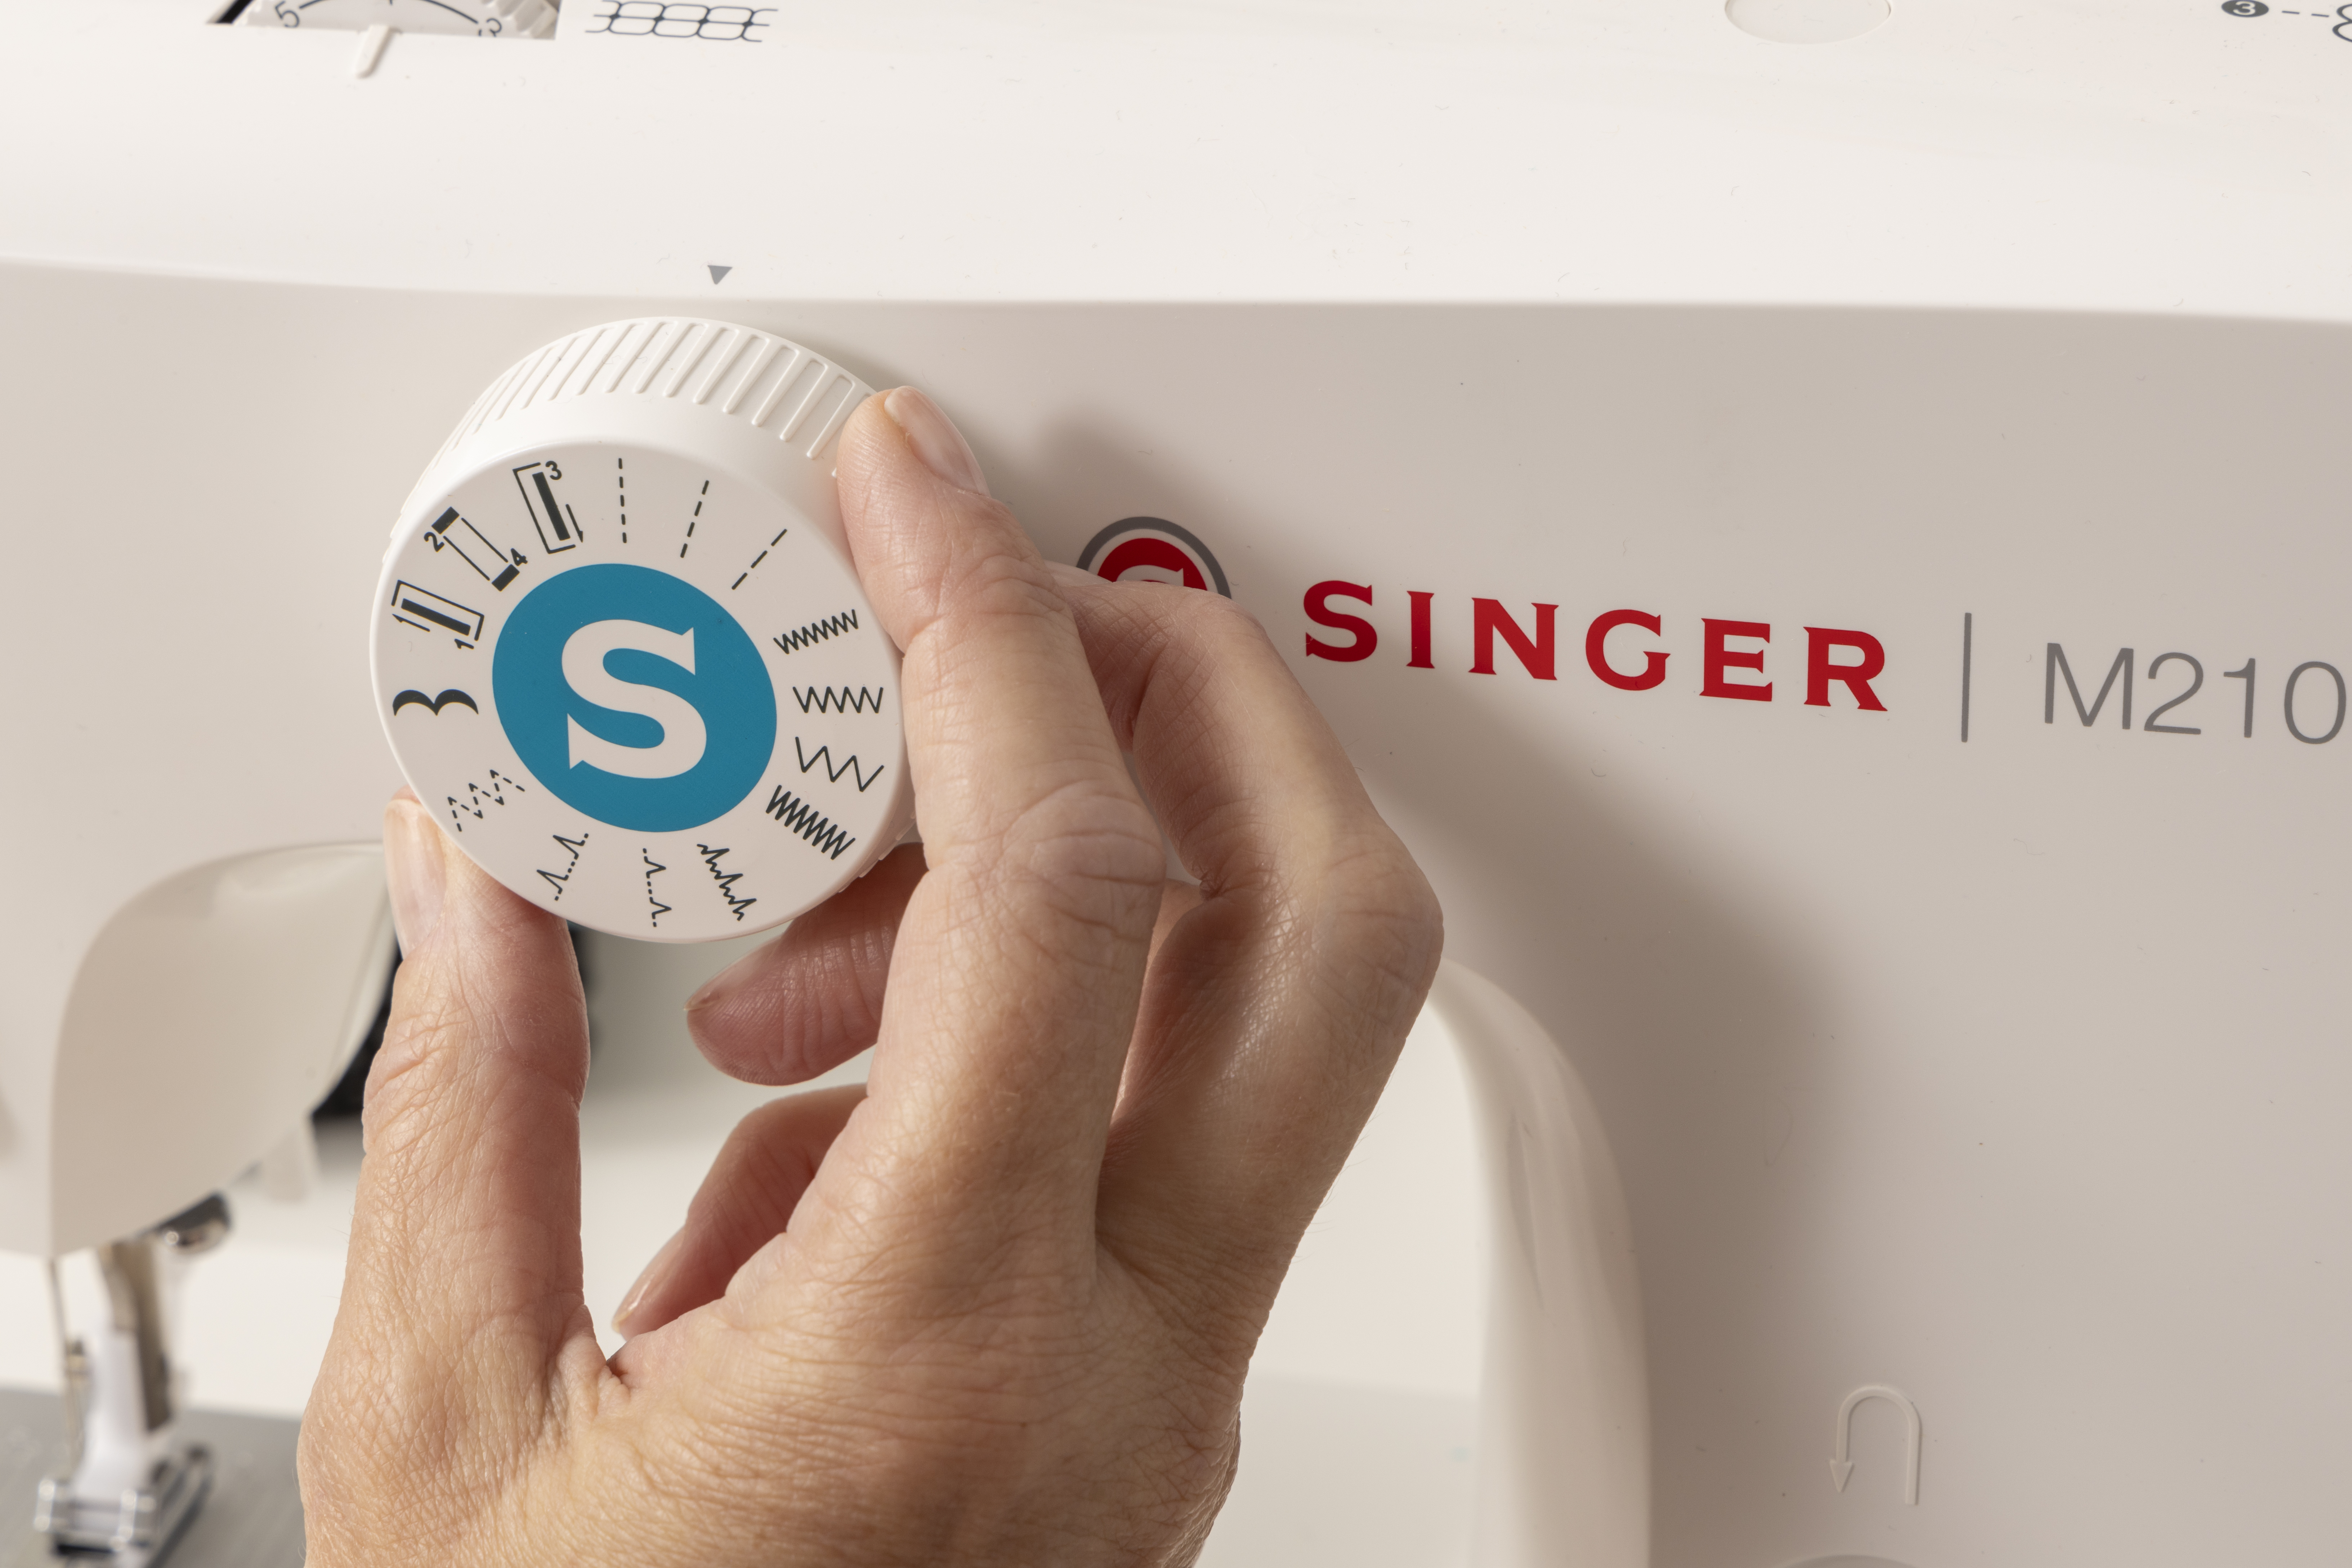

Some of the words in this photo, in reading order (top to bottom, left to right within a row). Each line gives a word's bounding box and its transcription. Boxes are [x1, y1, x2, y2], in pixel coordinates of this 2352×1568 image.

[275, 0, 300, 28] 5
[2233, 1, 2256, 15] 3
[545, 460, 562, 480] 3
[424, 532, 445, 552] 2
[510, 548, 528, 566] 4
[454, 638, 474, 650] 1
[1303, 580, 1887, 712] SINGER
[2044, 642, 2347, 745] M210
[562, 619, 707, 779] S
